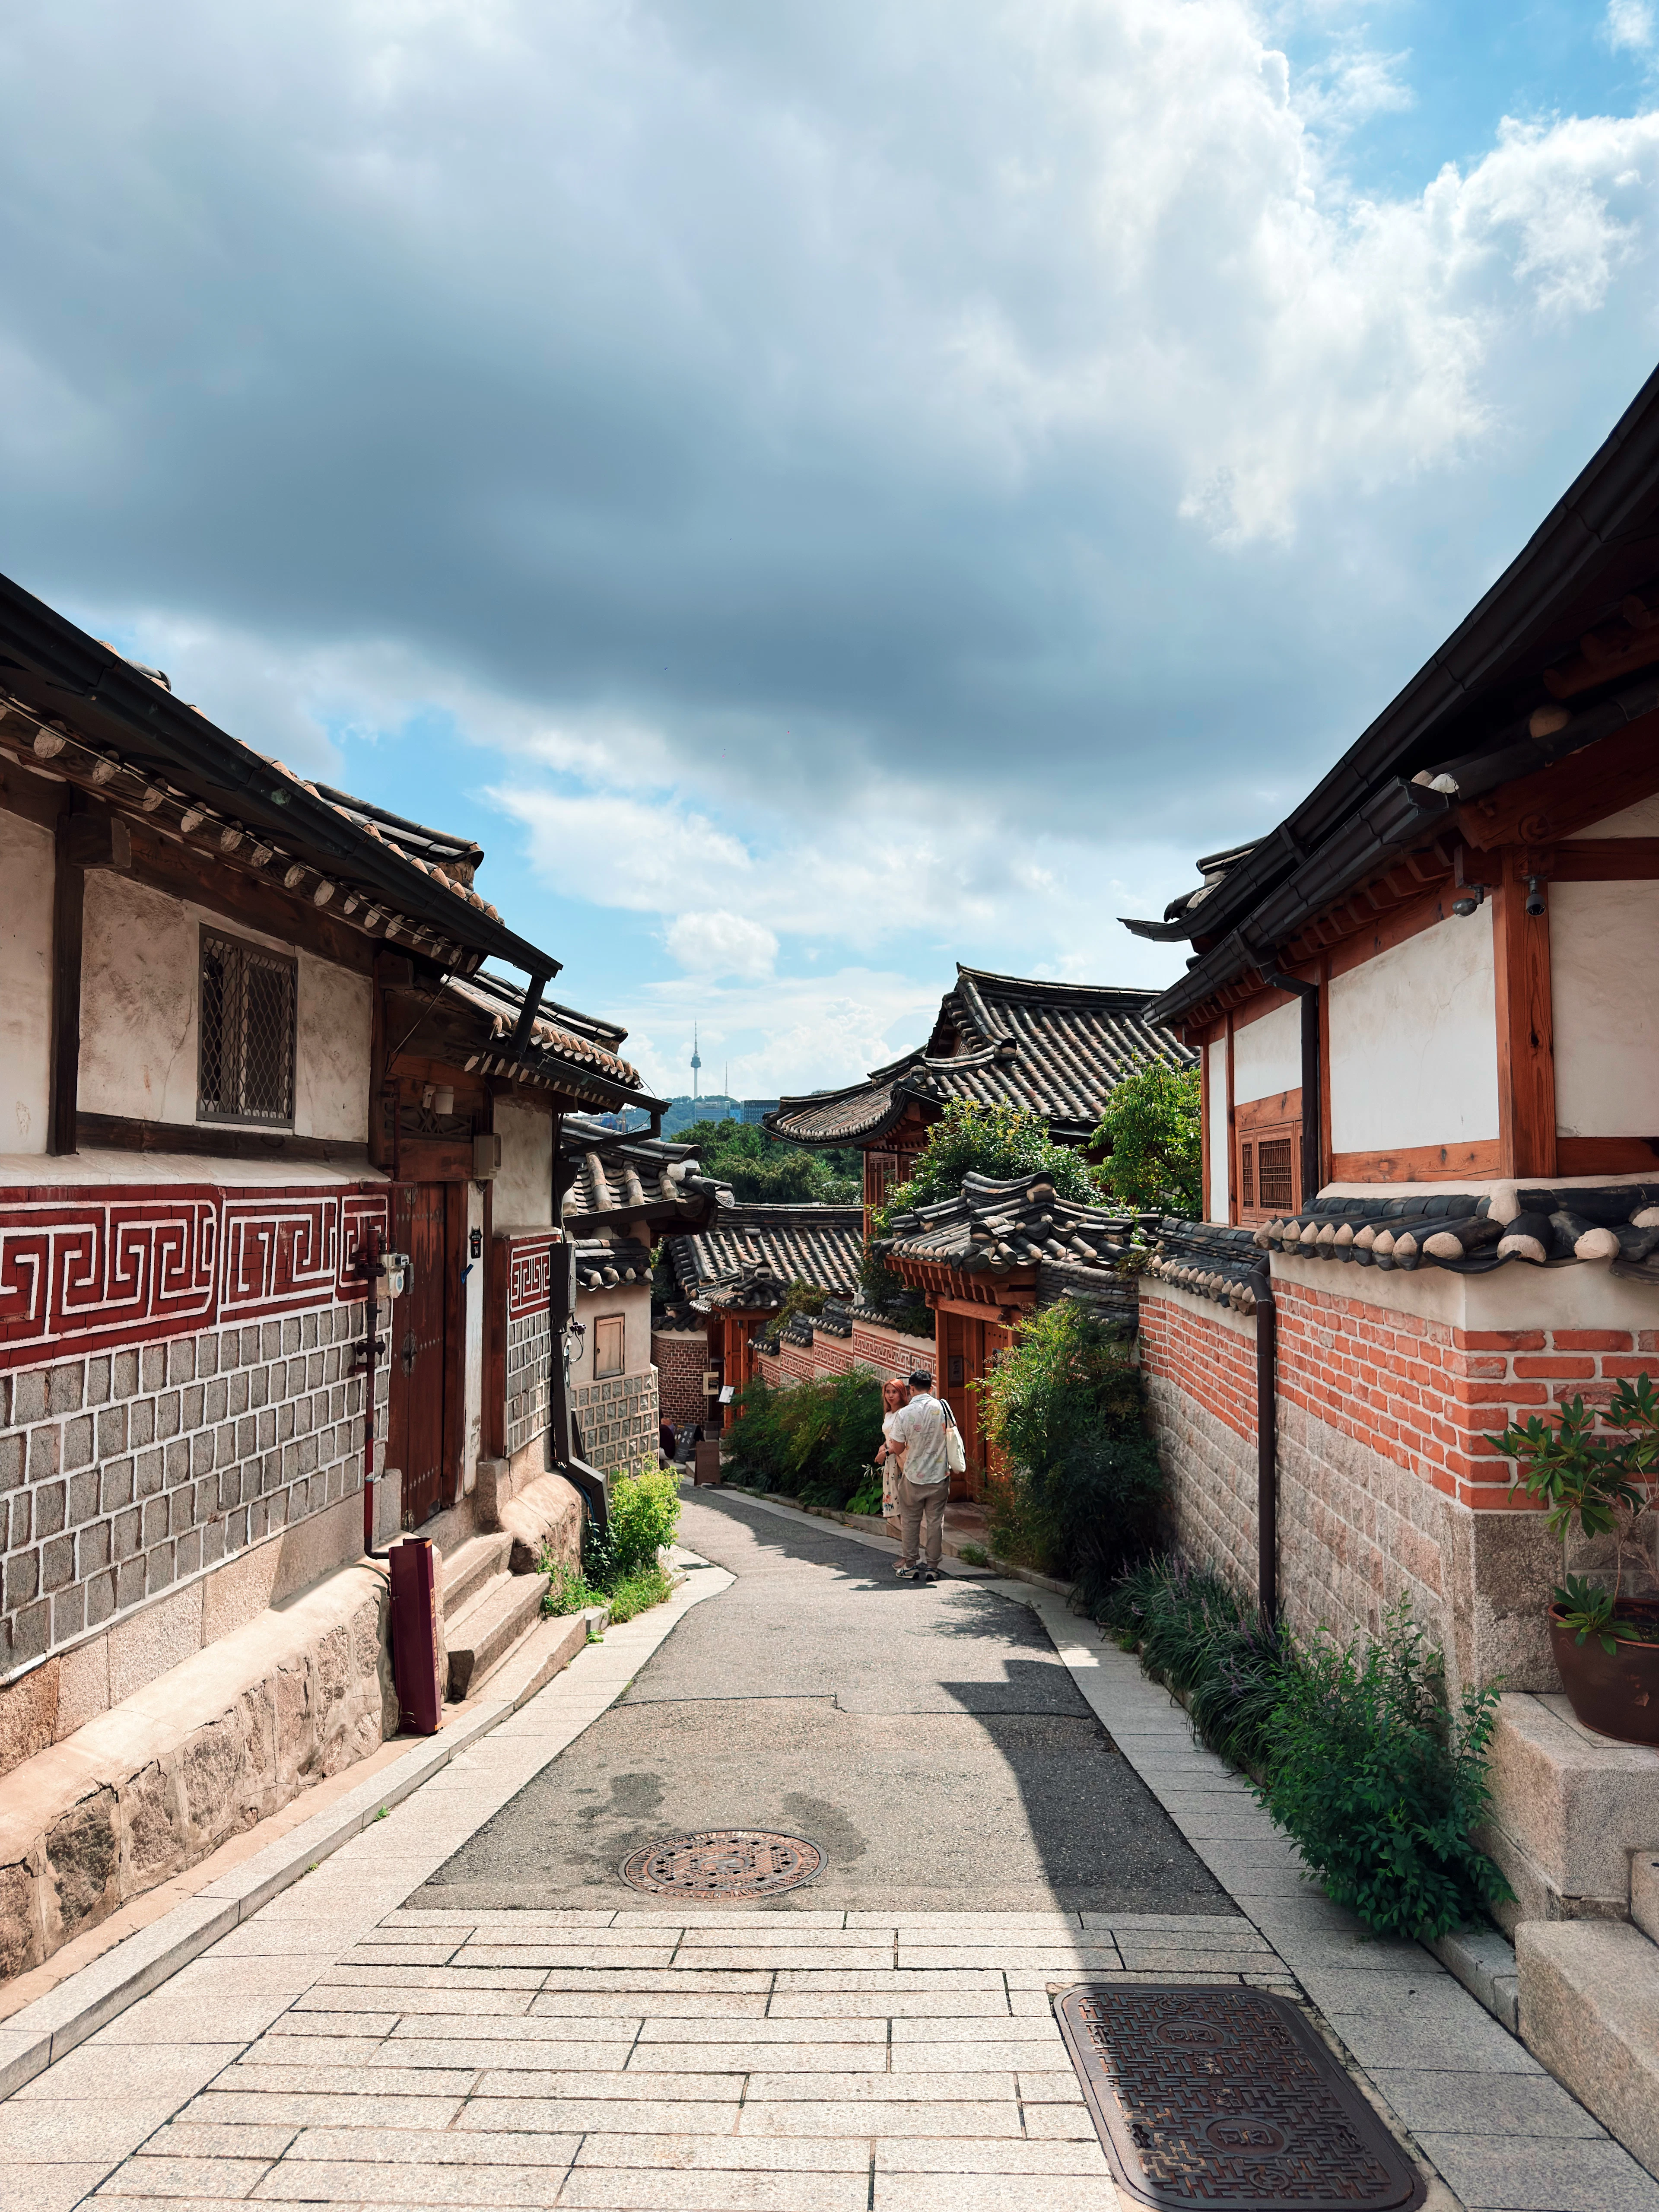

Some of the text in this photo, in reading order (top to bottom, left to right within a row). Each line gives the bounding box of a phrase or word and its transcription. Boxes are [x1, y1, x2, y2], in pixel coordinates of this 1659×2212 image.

[474, 1246, 478, 1255] 14
[686, 1832, 725, 1841] SEOUL
[725, 1886, 766, 1897] SEOUL
